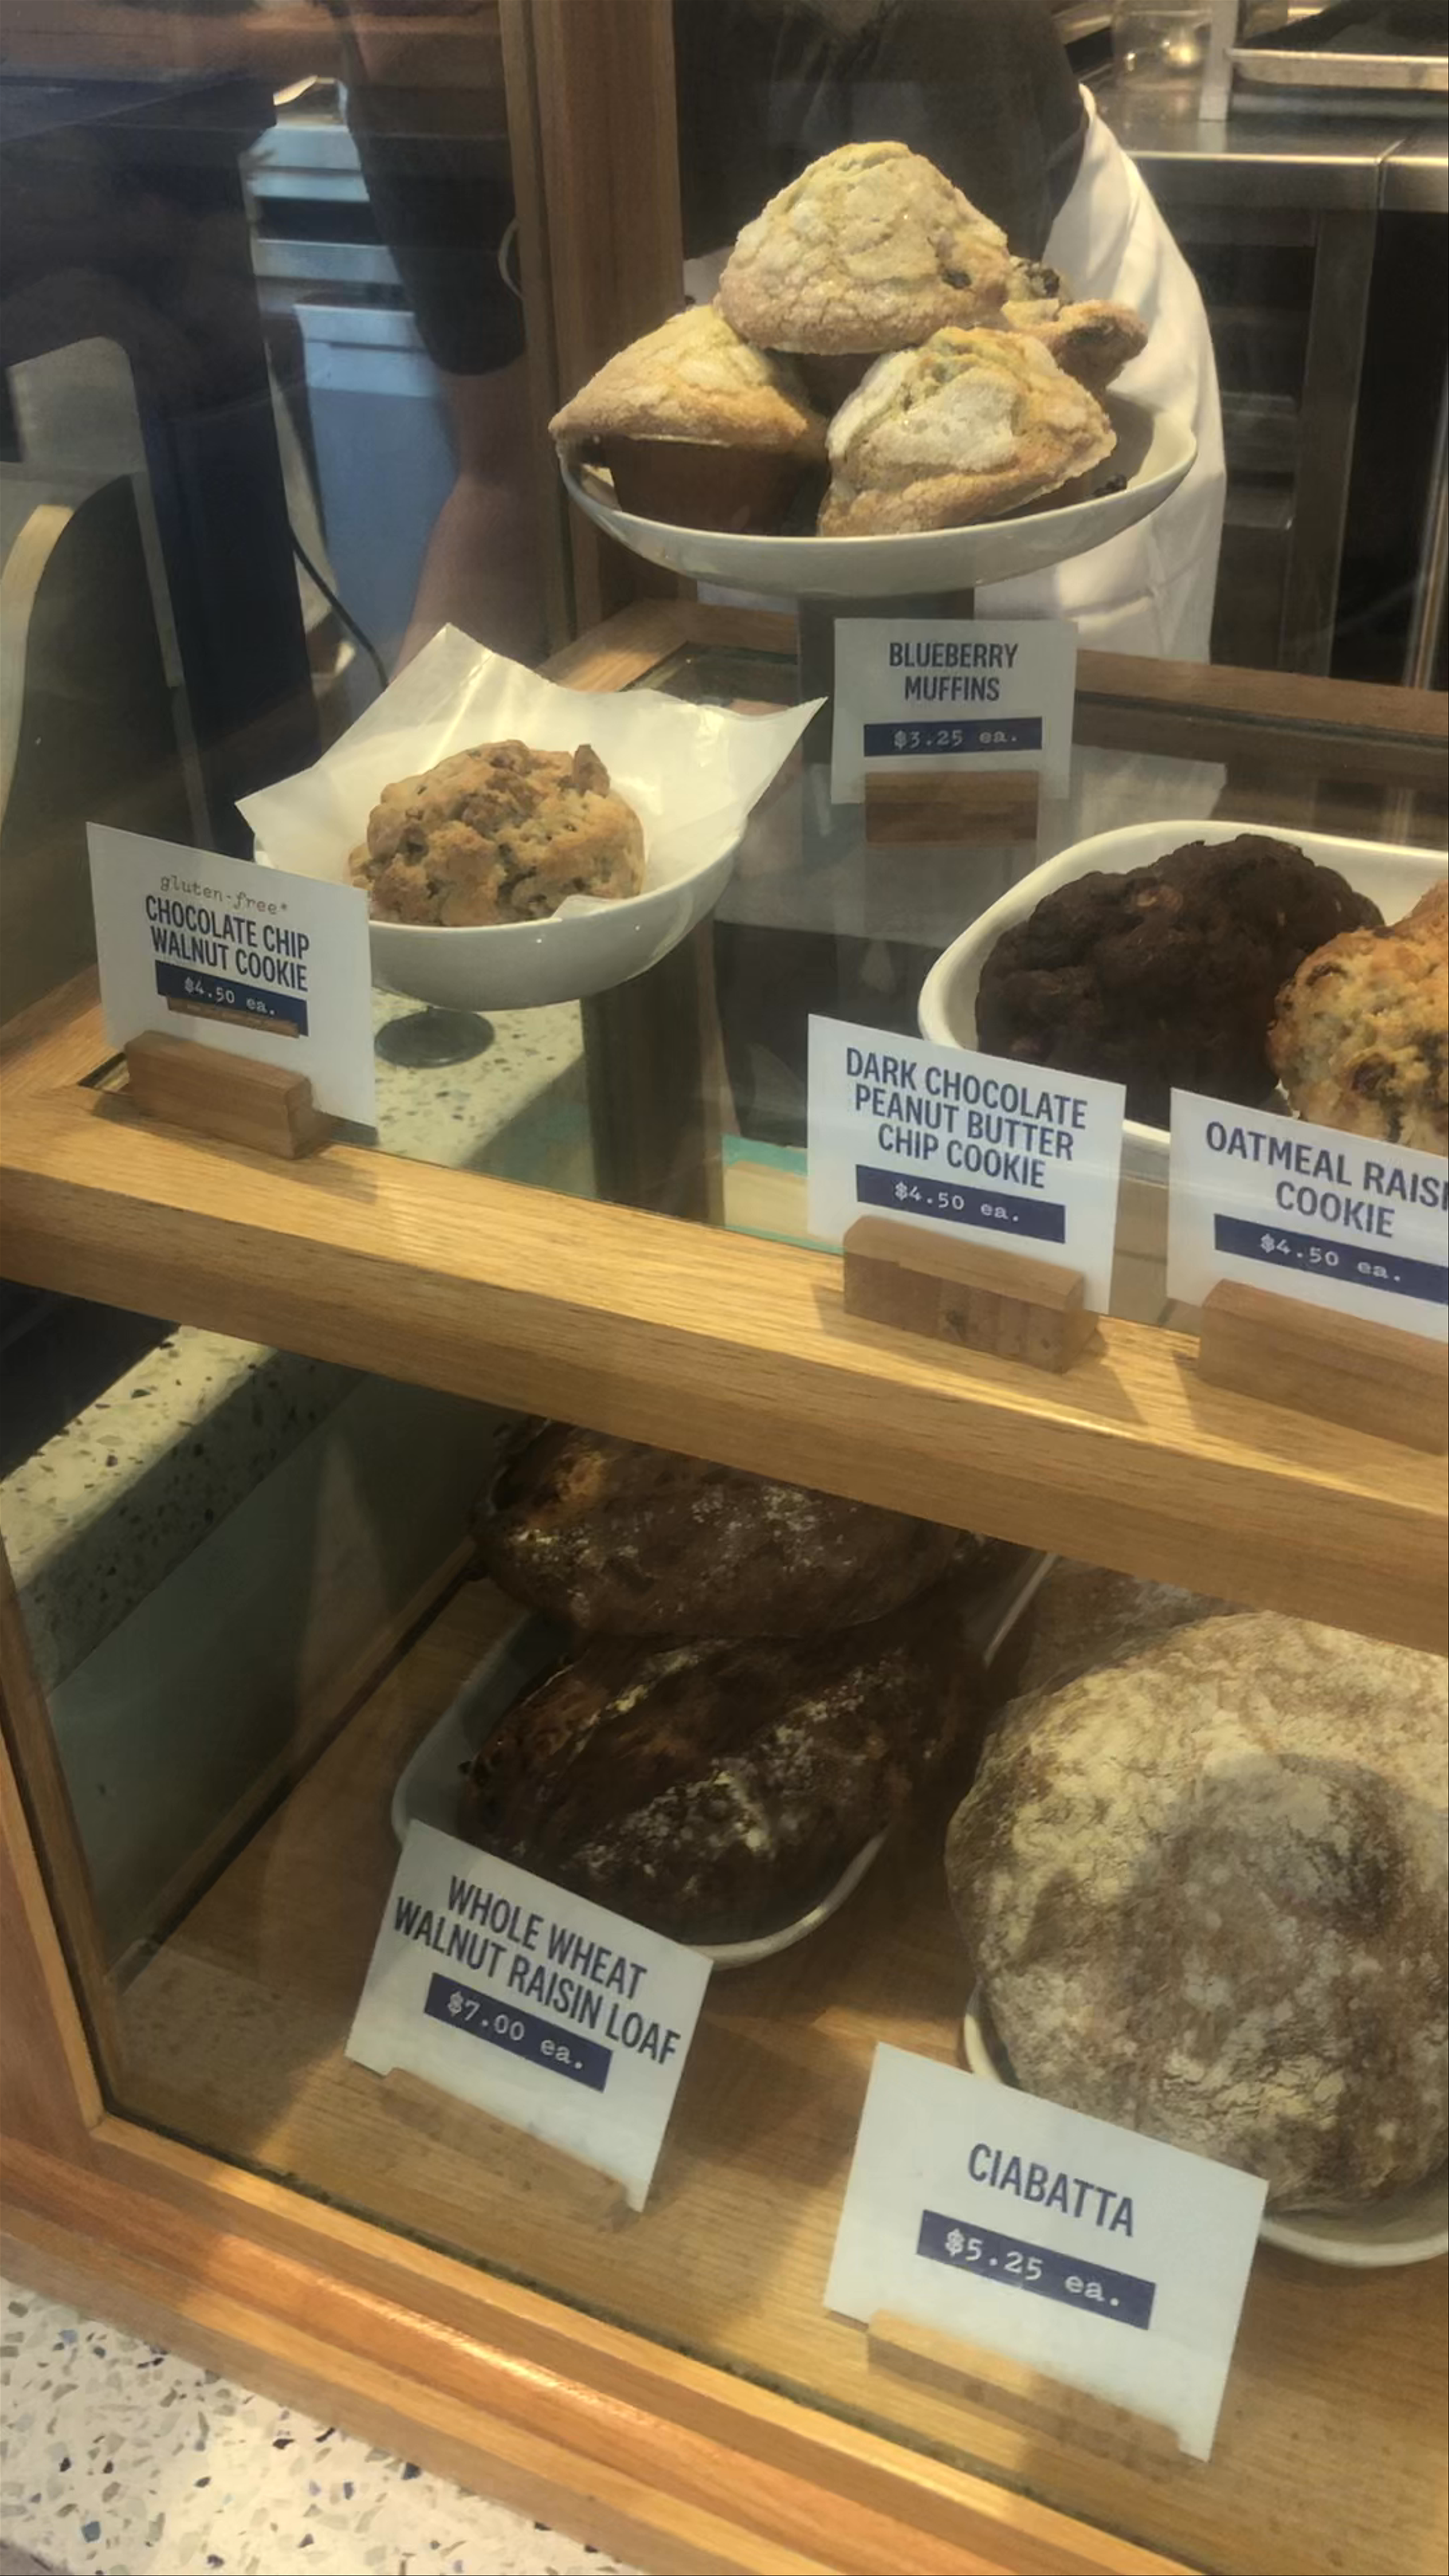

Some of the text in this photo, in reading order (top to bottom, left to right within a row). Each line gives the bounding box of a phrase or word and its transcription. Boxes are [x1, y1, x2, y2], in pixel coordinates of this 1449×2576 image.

[889, 643, 1018, 668] BLUEBERRY
[905, 677, 1000, 701] MUFFINS
[894, 730, 1017, 750] $3.25 ea.
[146, 895, 309, 960] CHOCOLATE CHIP
[151, 926, 308, 992] WALNUT COOKIE
[185, 977, 275, 1015] $4.50 ea.
[846, 1047, 1088, 1130] DARK CHOCOLATE
[856, 1084, 1074, 1161] PEANUT BUTTER
[1206, 1121, 1352, 1186] OATMEAL
[878, 1124, 1046, 1189] CHIP COOKIE
[895, 1181, 1018, 1222] $4.50 ea.
[1276, 1181, 1395, 1238] COOKIE
[1260, 1233, 1400, 1281] $4.50 ea.
[448, 1875, 647, 1999] WHOLE WHEAT
[394, 1896, 681, 2065] WALNUT RAISIN LOAF
[447, 1991, 583, 2069] $7.00 ea.
[968, 2143, 1134, 2237] CIABATTA
[945, 2228, 1119, 2306] $5.25 ea.
